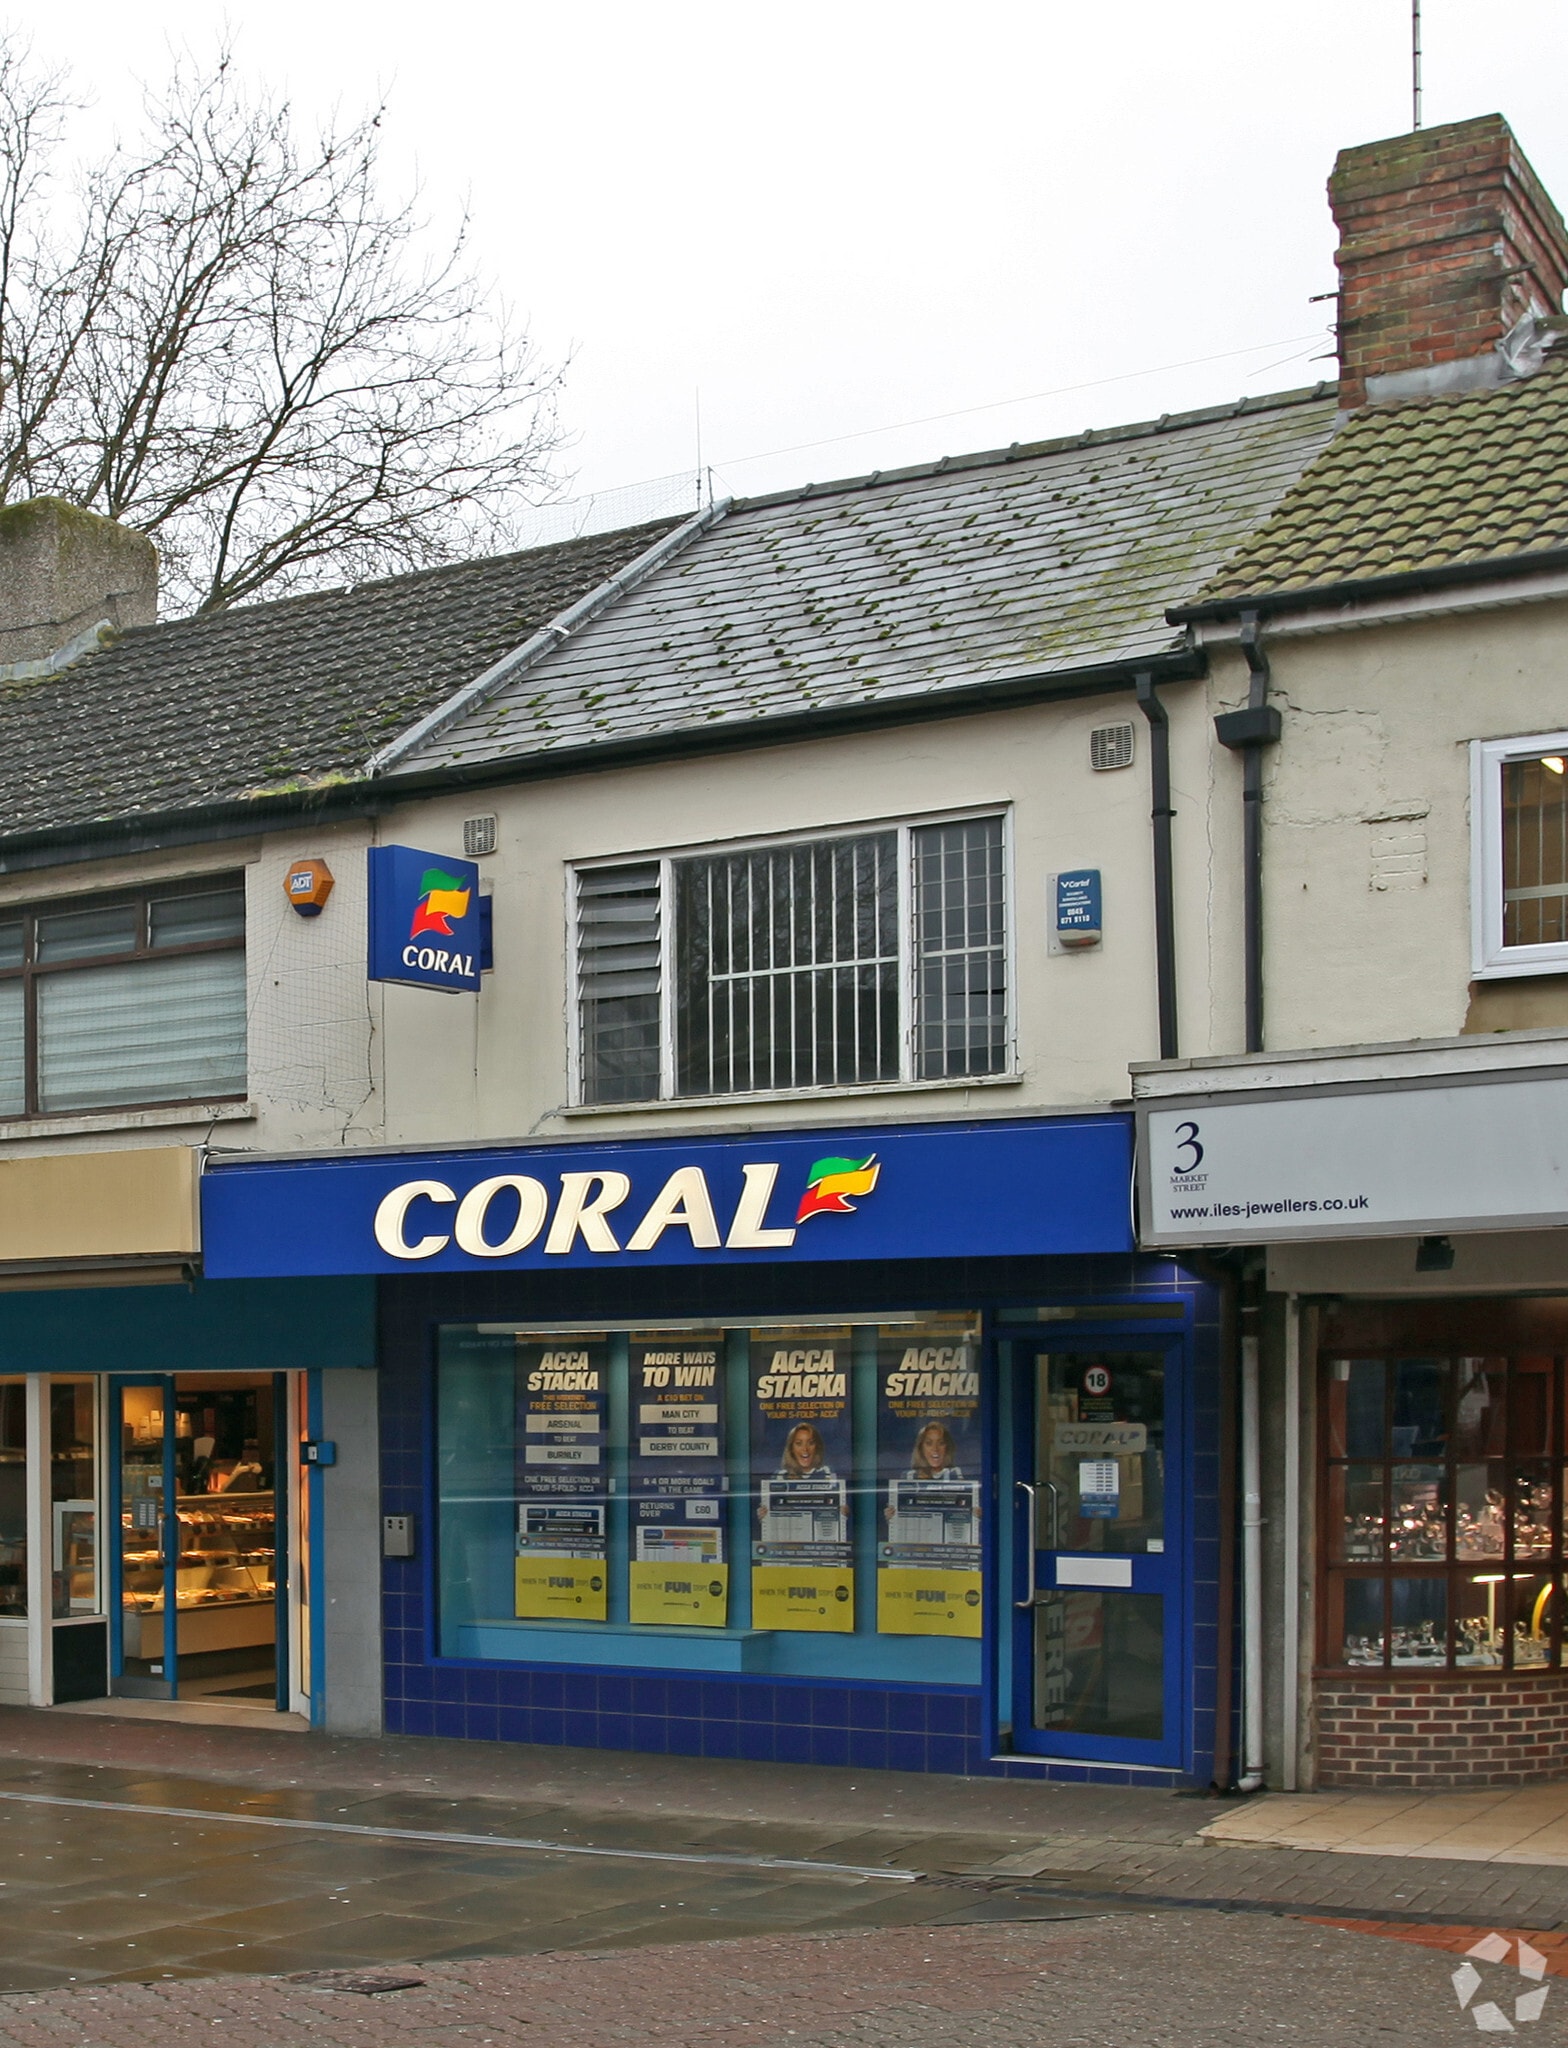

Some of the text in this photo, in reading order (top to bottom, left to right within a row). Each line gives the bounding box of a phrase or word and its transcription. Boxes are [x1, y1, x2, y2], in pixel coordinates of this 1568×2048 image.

[291, 875, 312, 890] ADT
[402, 944, 476, 977] CORAL
[1173, 1121, 1204, 1175] 3
[1170, 1173, 1209, 1184] MARKET
[1173, 1183, 1206, 1193] STREET
[373, 1163, 797, 1260] CORAL
[1170, 1195, 1369, 1219] www.iles-jewellers.co.uk
[539, 1351, 589, 1370] ACCA
[643, 1351, 717, 1365] MORE WAYS
[770, 1350, 835, 1374] ACCA
[899, 1346, 967, 1371] ACCA
[527, 1371, 599, 1391] STACKA
[642, 1365, 716, 1388] TO WIN
[1088, 1373, 1106, 1388] 18
[757, 1374, 846, 1398] STACKA
[885, 1372, 979, 1397] STACKA
[530, 1401, 597, 1411] FREE SELECTION
[797, 1401, 834, 1409] SELECTION
[662, 1410, 700, 1418] MAN CITY
[547, 1420, 581, 1429] ARSENAL
[668, 1426, 695, 1434] TO BEAT
[1060, 1431, 1128, 1445] CORAL
[650, 1442, 710, 1451] DERBY COUNTY
[547, 1451, 582, 1460] BURNLEY
[640, 1502, 675, 1510] RETURNS
[548, 1576, 575, 1588] FUN
[664, 1581, 692, 1593] FUN
[788, 1587, 817, 1599] FUN
[916, 1589, 946, 1603] FUN
